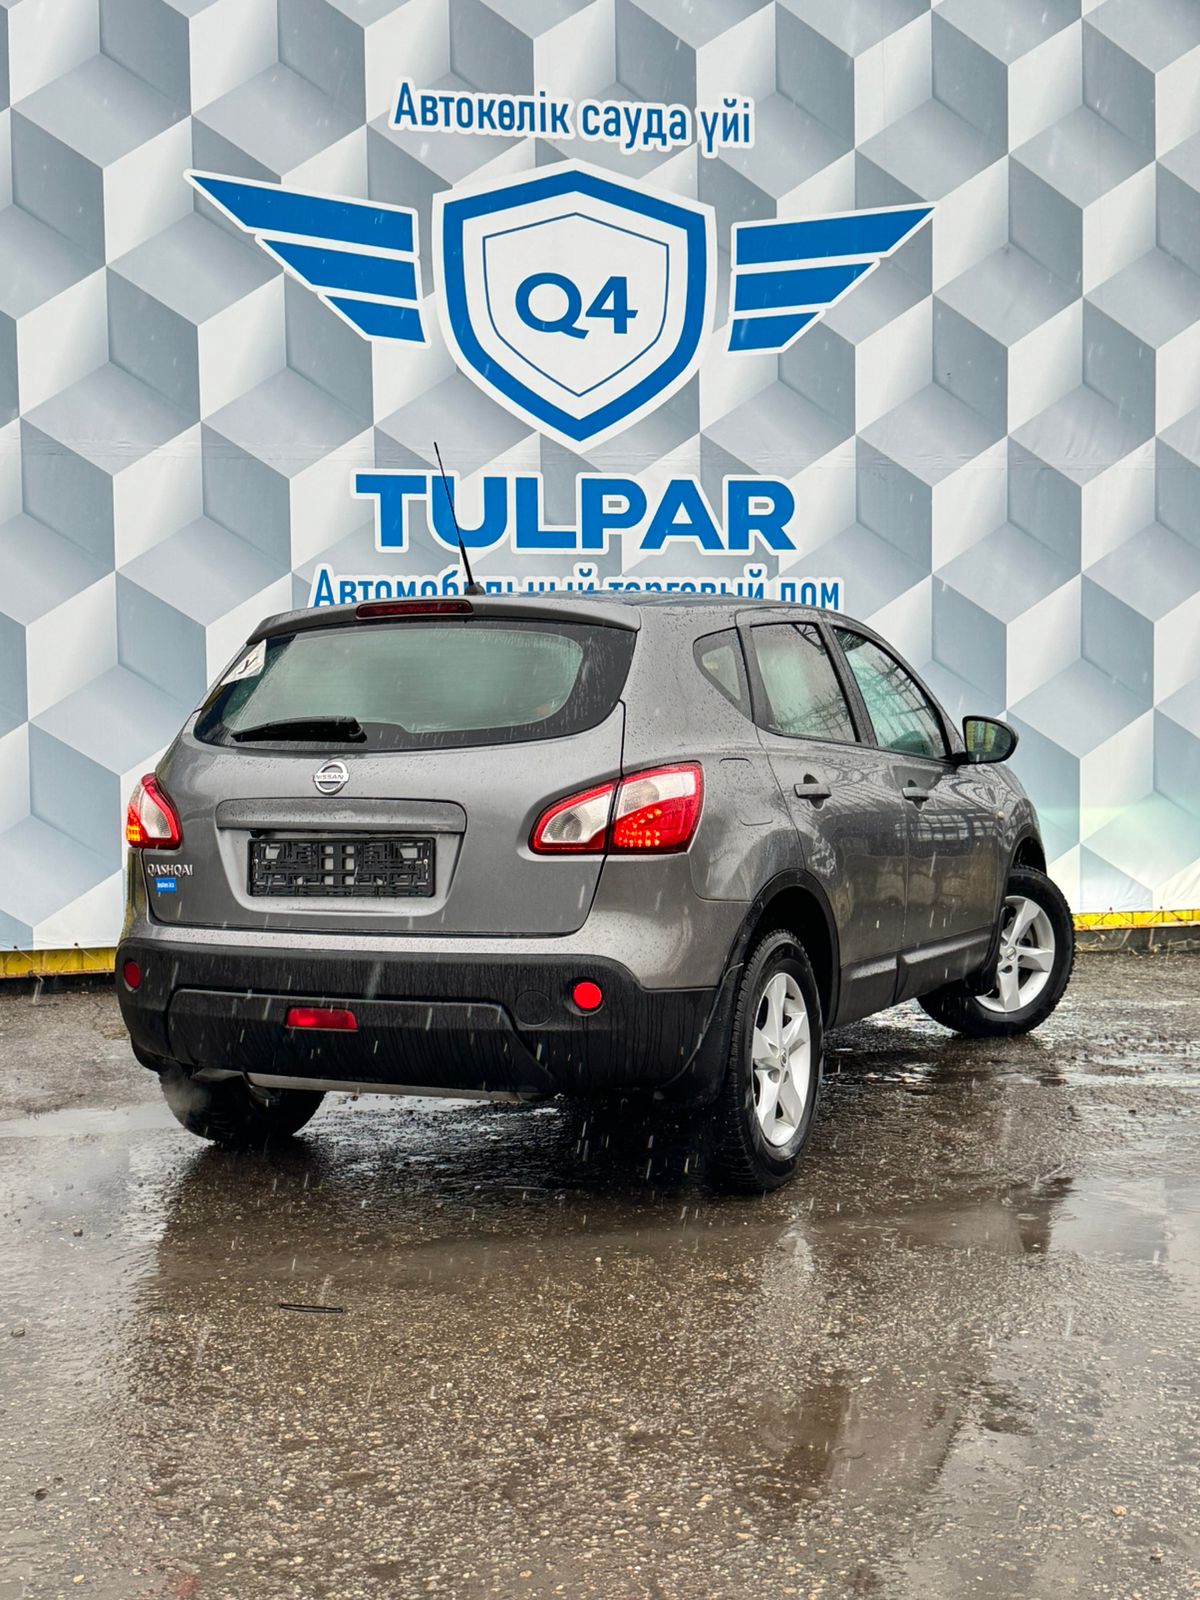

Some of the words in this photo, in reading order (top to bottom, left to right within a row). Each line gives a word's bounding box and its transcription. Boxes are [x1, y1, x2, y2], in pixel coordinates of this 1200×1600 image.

[394, 82, 570, 134] Автокөлік
[581, 103, 687, 149] сауда
[700, 97, 750, 153] үйі
[515, 272, 638, 339] Q4
[355, 473, 797, 551] TULPAR
[147, 863, 193, 877] QASHQAI
